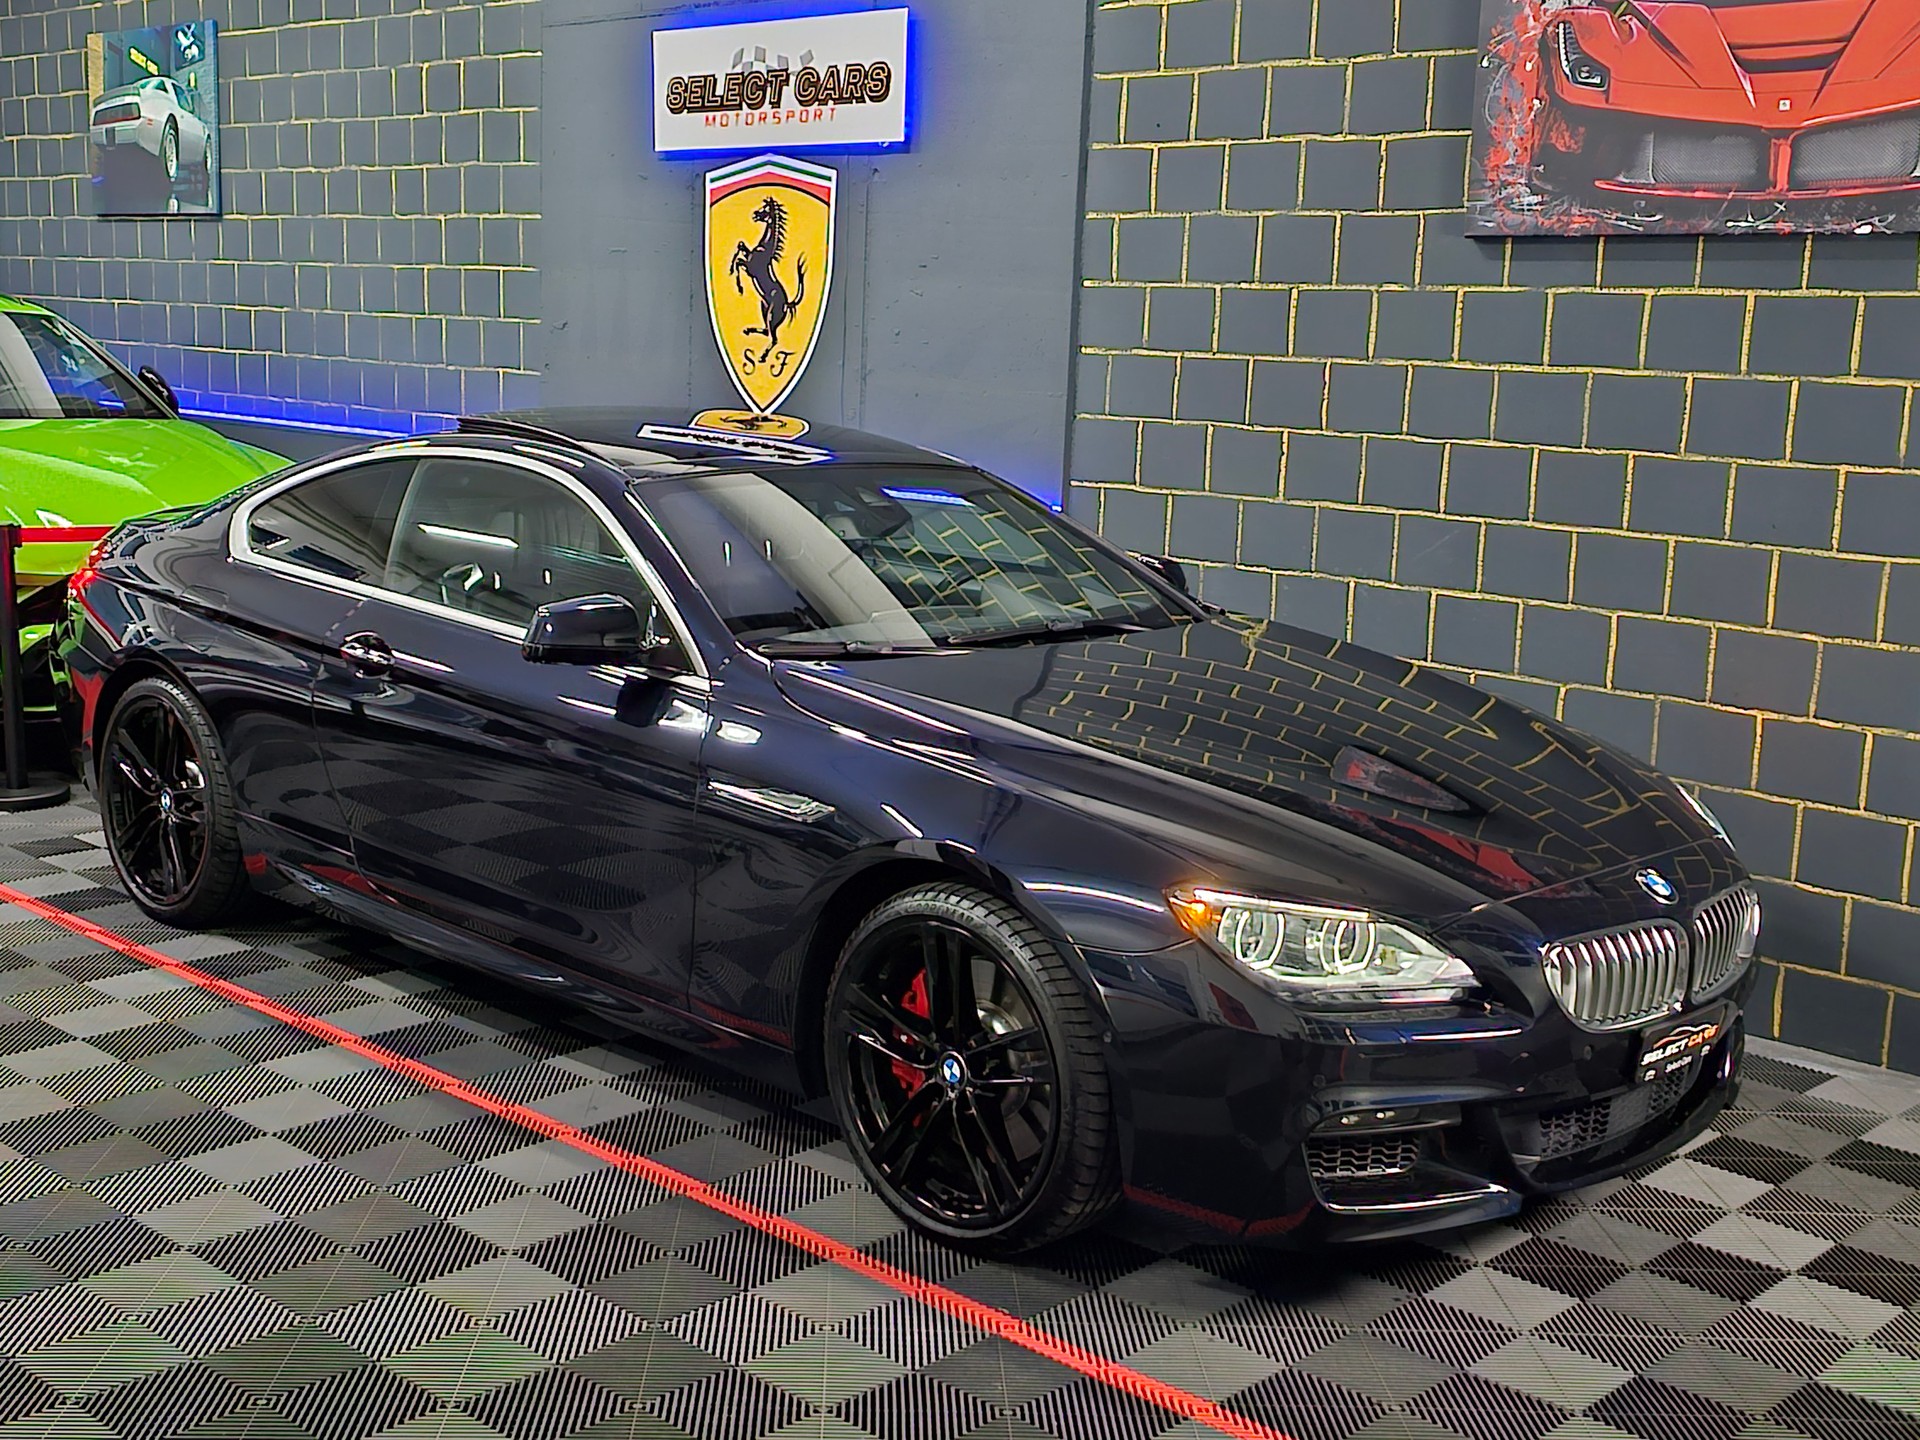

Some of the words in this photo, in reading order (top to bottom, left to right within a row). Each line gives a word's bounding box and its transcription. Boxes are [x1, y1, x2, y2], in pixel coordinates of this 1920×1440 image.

[666, 69, 790, 114] SELECT
[794, 61, 892, 107] CARS
[705, 107, 837, 127] MOTORSPORT
[1640, 1038, 1689, 1066] SELECT
